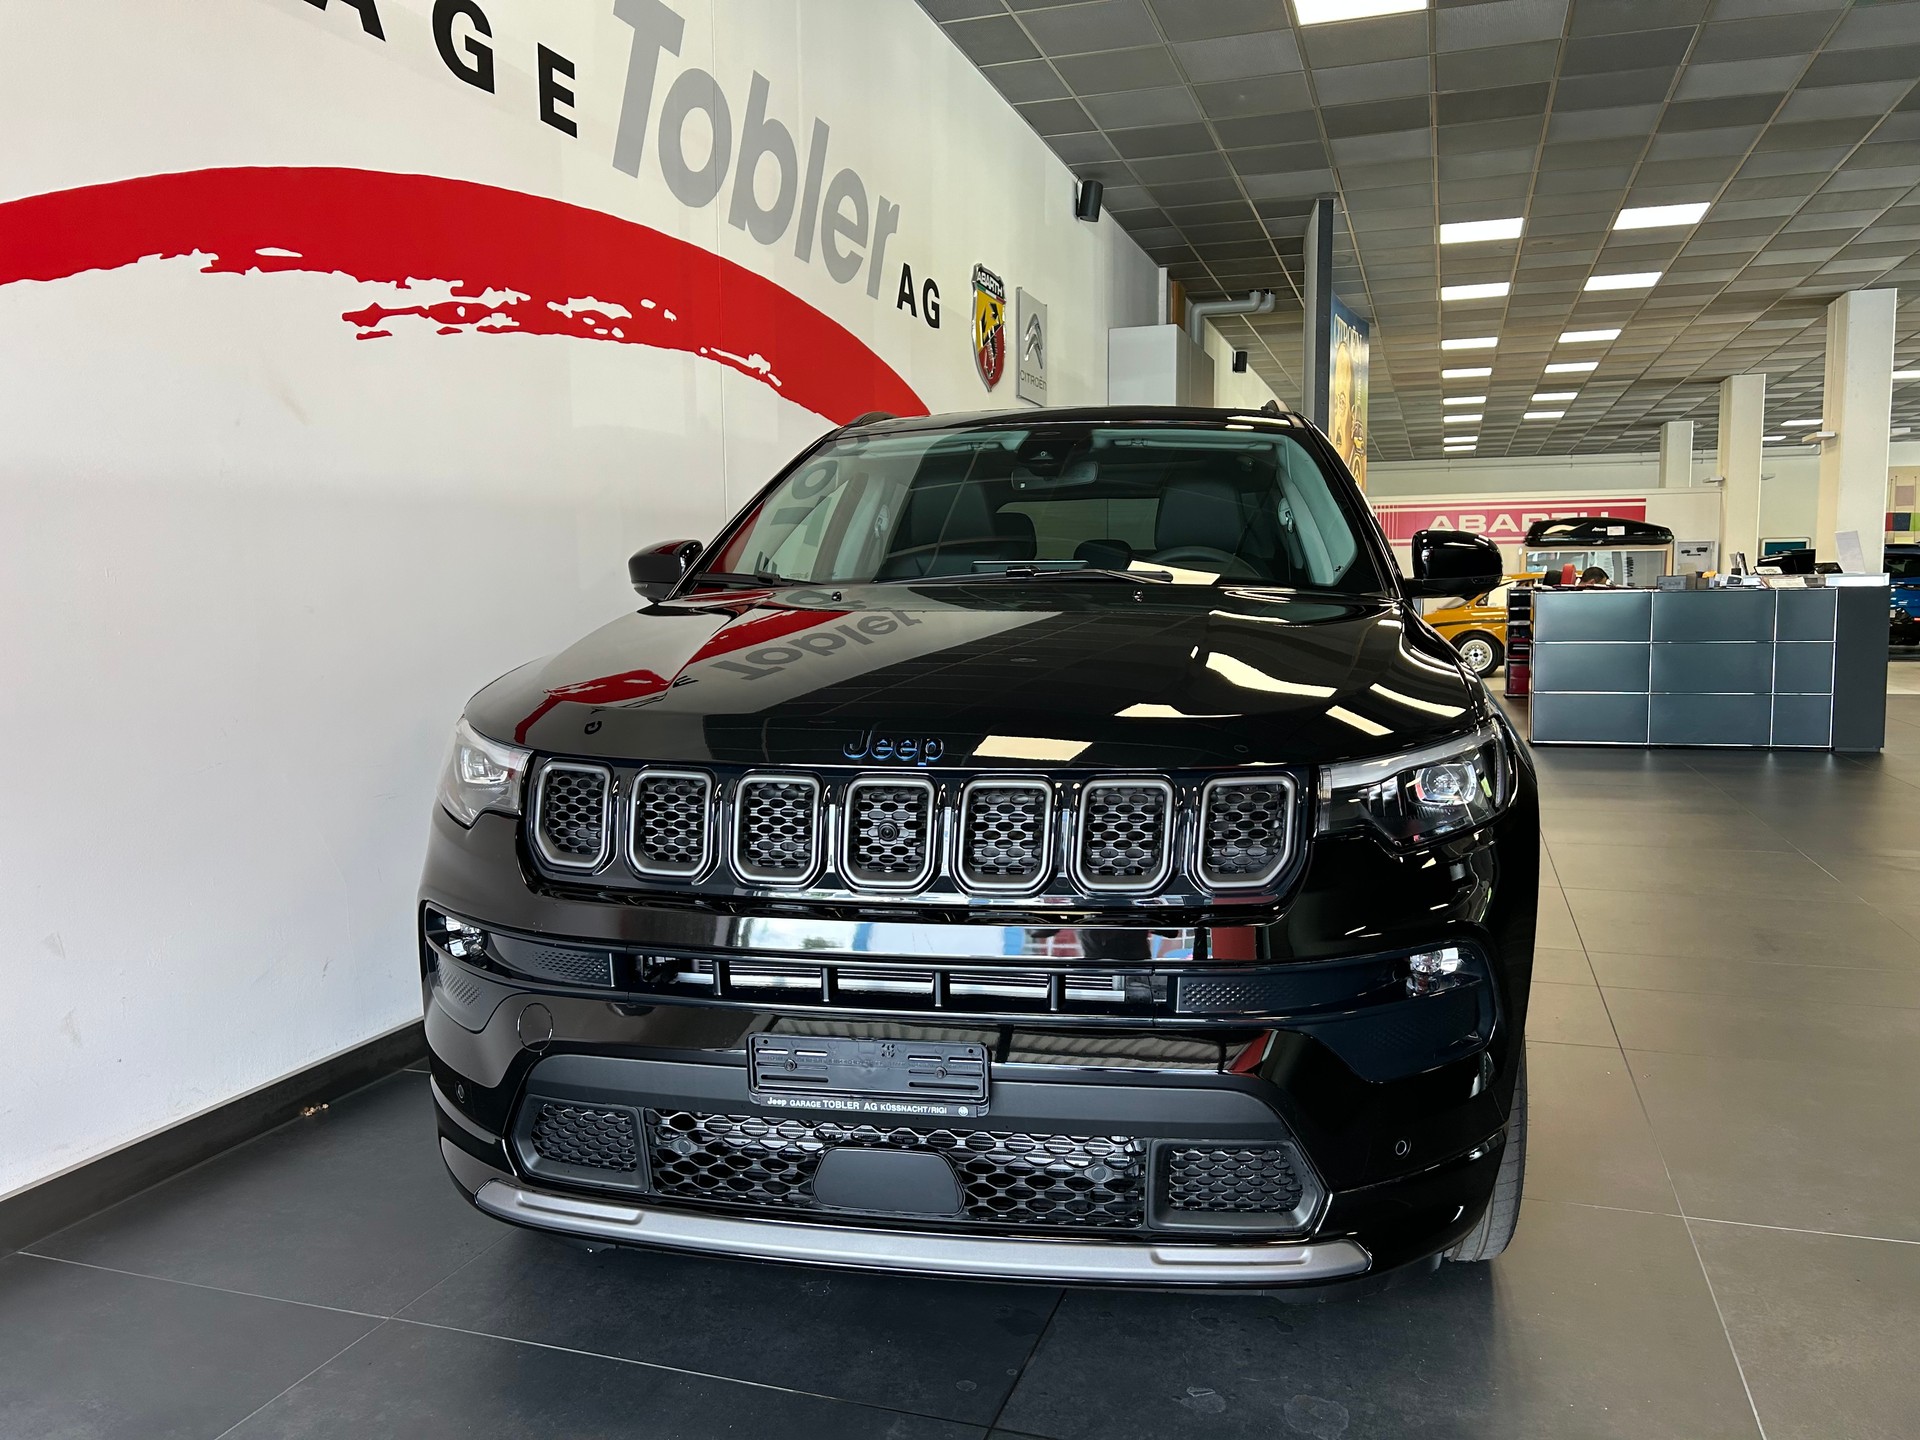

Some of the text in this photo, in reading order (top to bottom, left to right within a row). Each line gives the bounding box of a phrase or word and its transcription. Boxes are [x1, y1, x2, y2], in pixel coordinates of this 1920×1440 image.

[612, 0, 900, 300] Tobler
[897, 263, 940, 329] AG
[976, 271, 1004, 297] ABARTH
[843, 730, 945, 766] Jeep
[767, 1097, 948, 1114] Jeep GARAGE TOBLER AG KÜSSNACHT/RIGI
